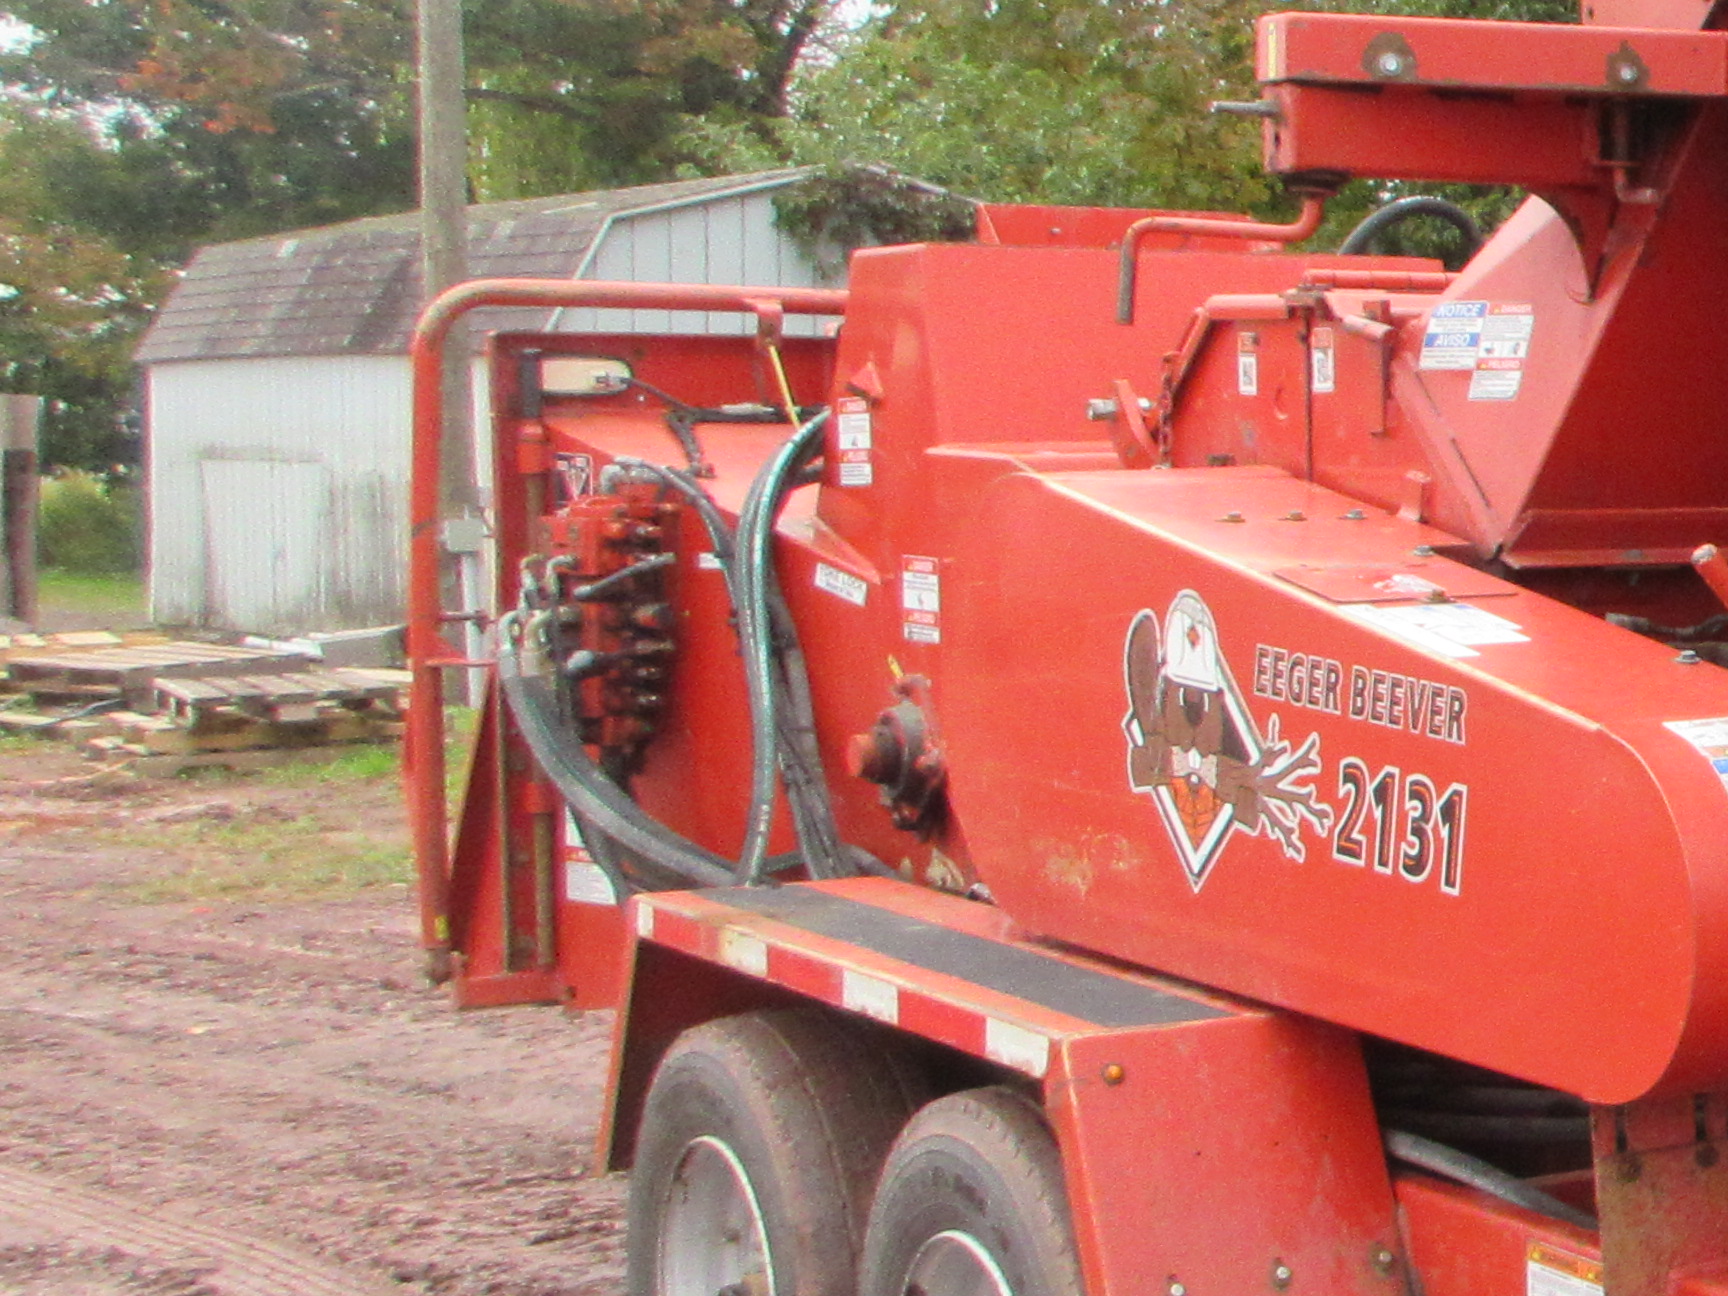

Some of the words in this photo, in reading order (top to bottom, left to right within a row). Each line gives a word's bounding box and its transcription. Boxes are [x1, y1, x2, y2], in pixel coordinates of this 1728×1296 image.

[1437, 304, 1481, 317] NOTICE
[1435, 334, 1470, 347] AVISO
[1254, 644, 1343, 715] EEGER
[1349, 666, 1468, 745] BEEVER
[1333, 756, 1468, 896] 2131
